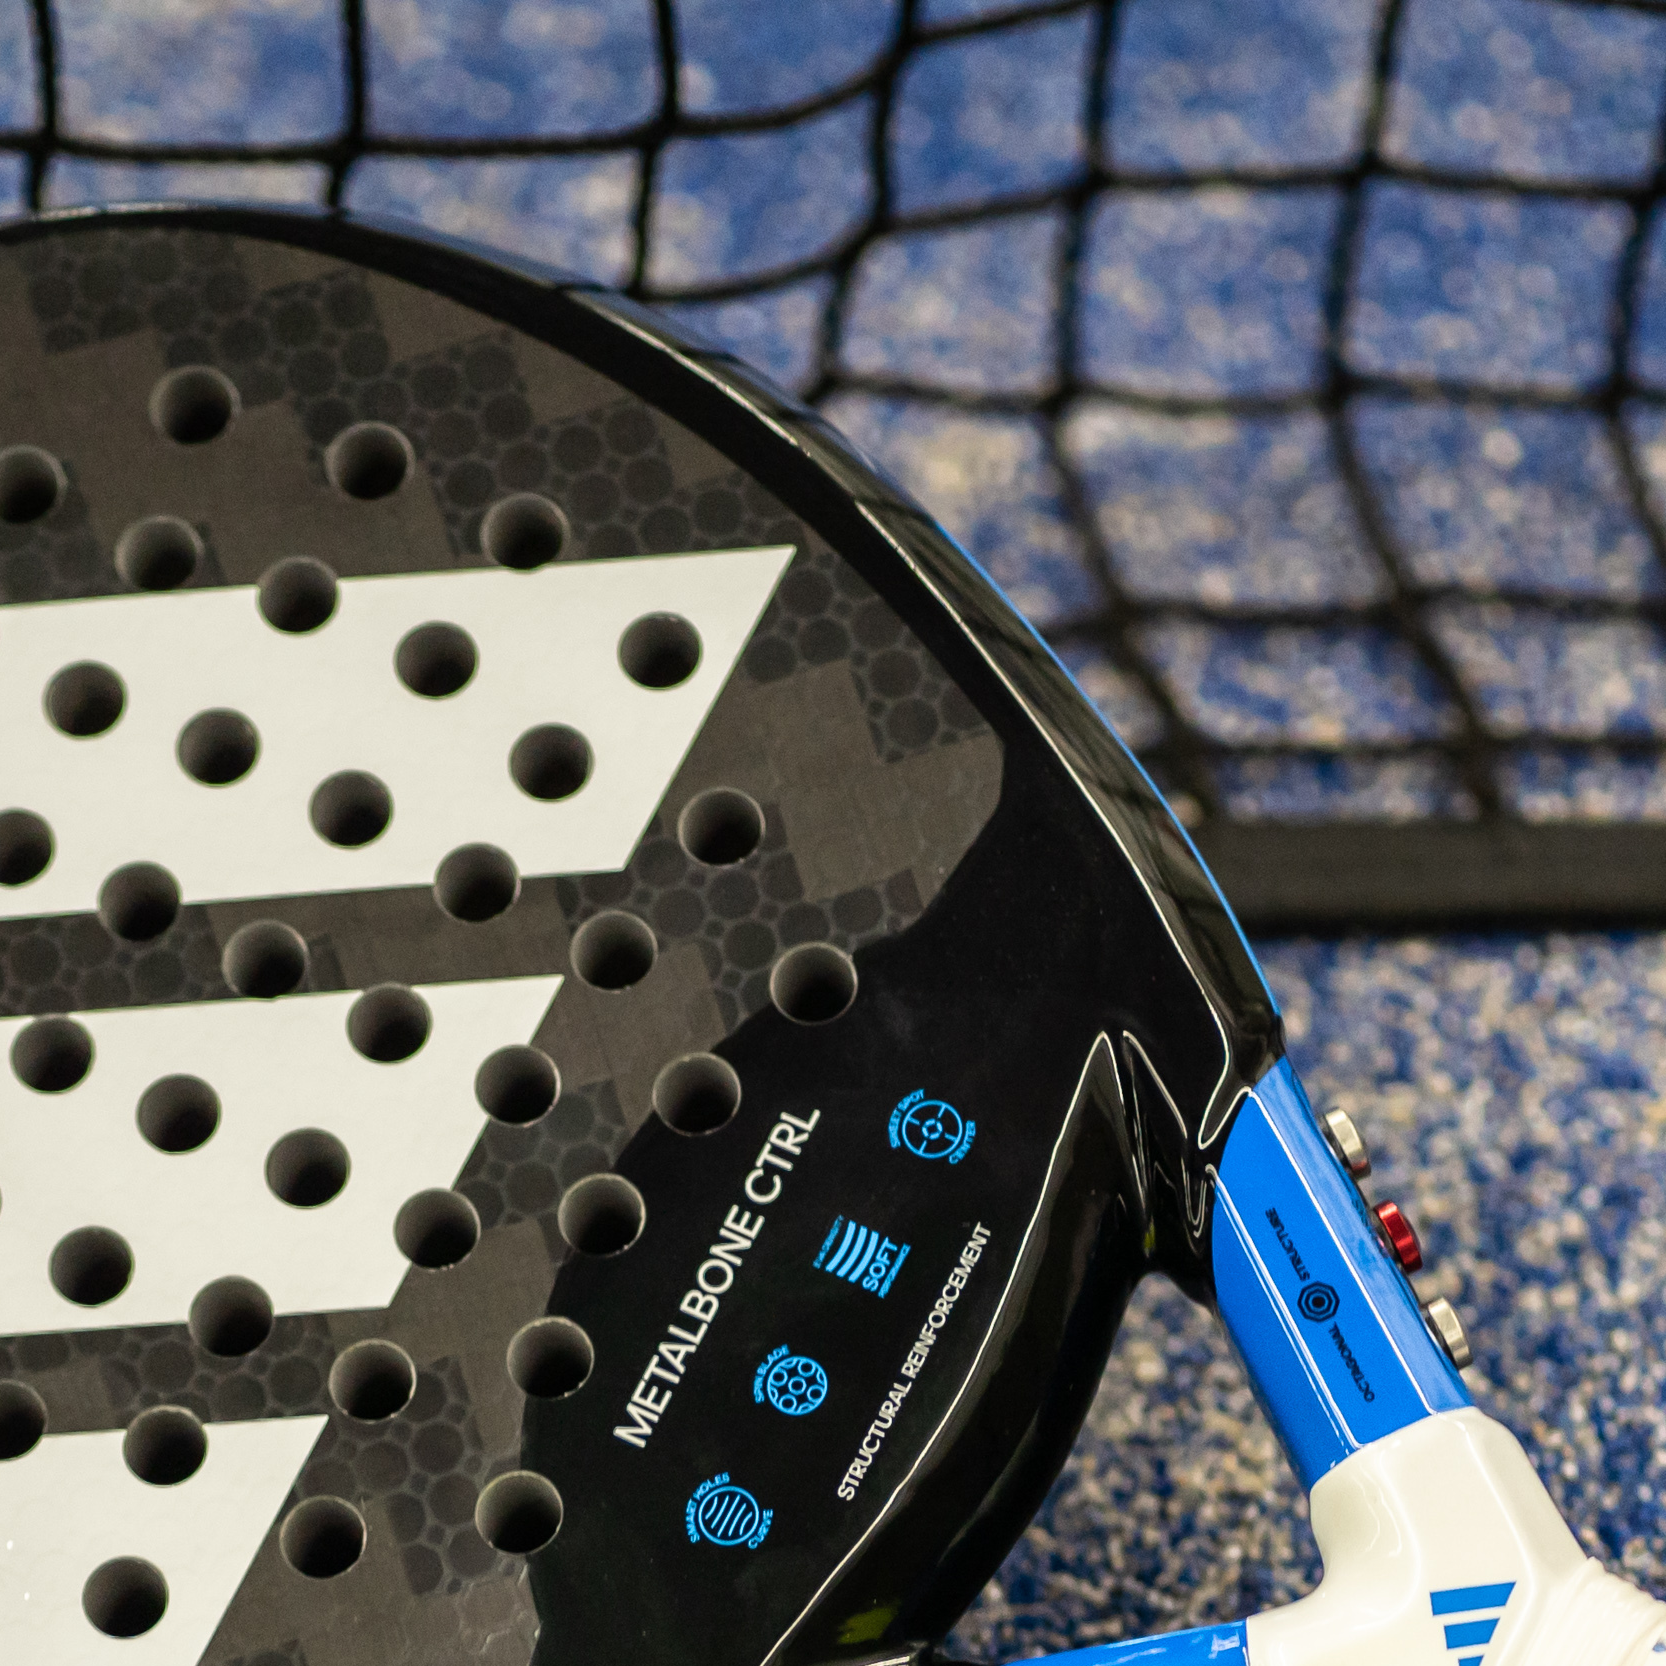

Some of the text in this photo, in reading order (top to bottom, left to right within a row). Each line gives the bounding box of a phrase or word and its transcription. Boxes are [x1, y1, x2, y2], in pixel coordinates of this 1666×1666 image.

[948, 1120, 976, 1165] CENTER
[614, 1110, 820, 1448] METALBONE CTRL
[862, 1236, 898, 1292] SOFT
[1266, 1208, 1374, 1402] OCTAGONAL STRUCTURE
[756, 1343, 790, 1376] BLADE
[838, 1222, 990, 1500] STRUCTURAL REINFORCEMENT
[685, 1471, 730, 1544] SMART HOLES
[747, 1508, 774, 1550] CURVE
